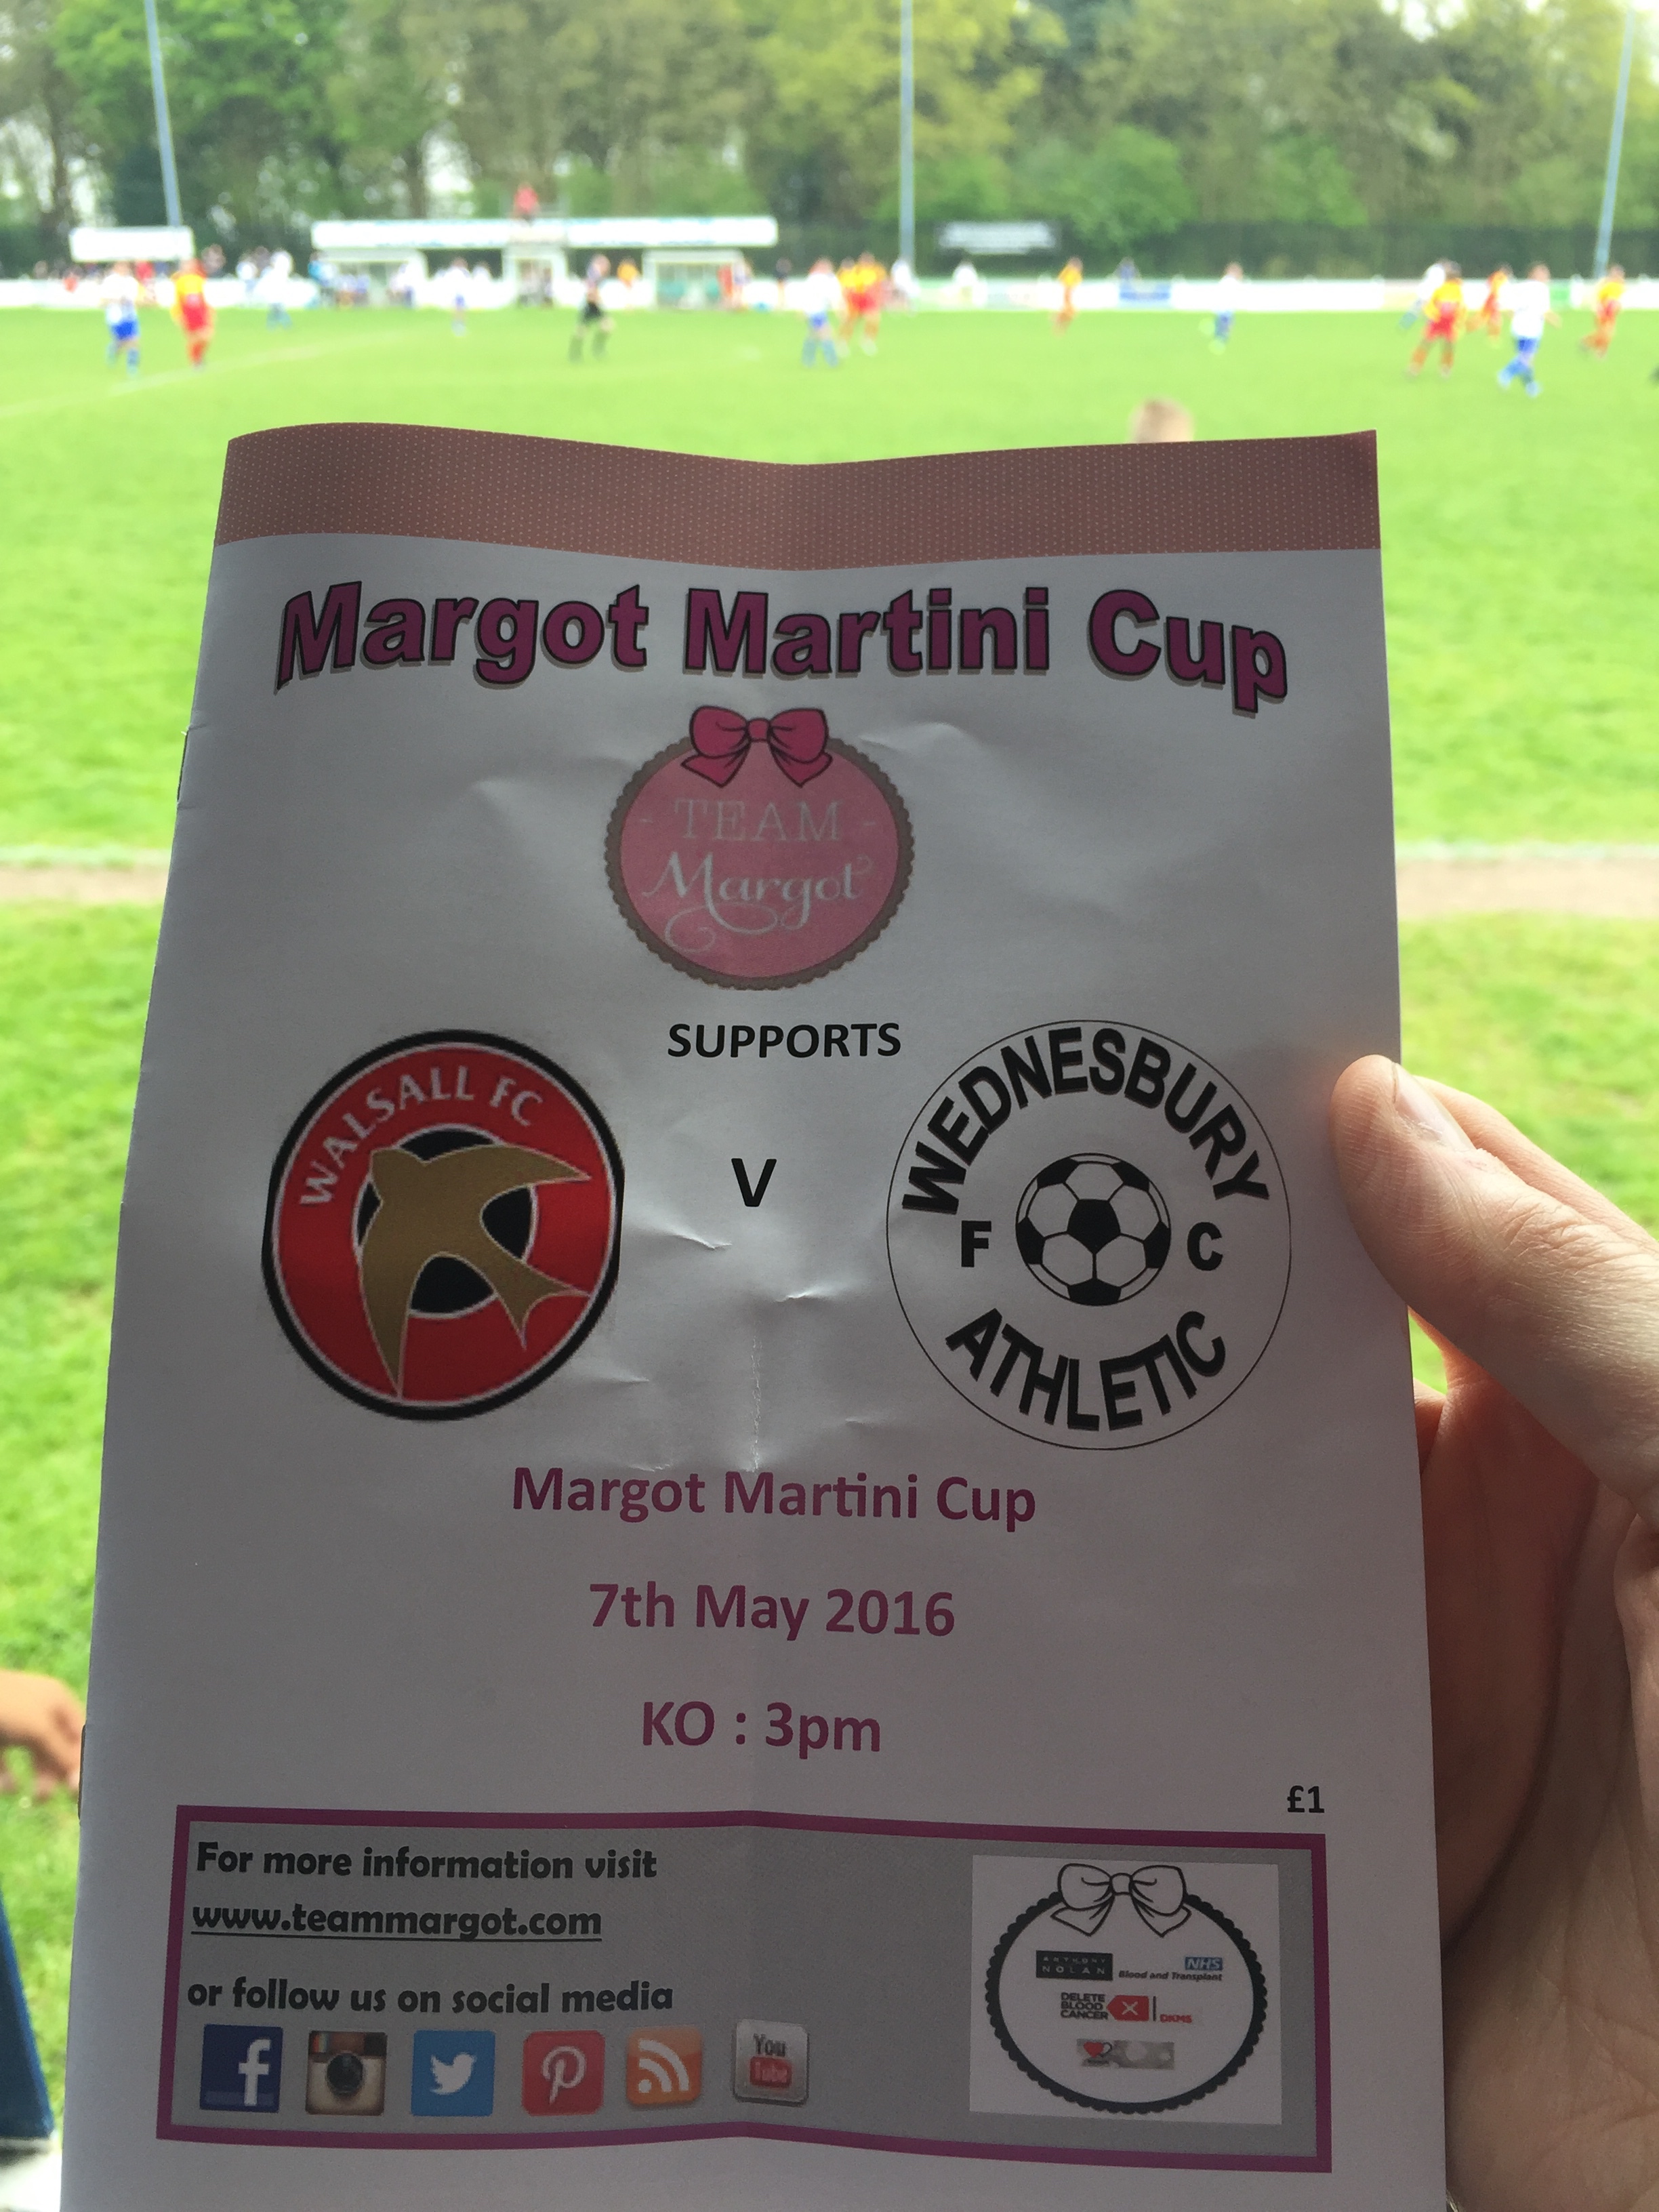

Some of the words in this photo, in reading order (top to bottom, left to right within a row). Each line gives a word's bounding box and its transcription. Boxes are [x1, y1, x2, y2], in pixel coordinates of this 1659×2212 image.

[274, 581, 649, 690] Margot
[683, 587, 1049, 676] Martini
[1088, 589, 1288, 718] Cup
[674, 797, 841, 842] TEAM
[641, 851, 874, 954] Margot
[668, 1023, 901, 1058] SUPPORTS
[300, 1065, 476, 1206] WALSALL
[489, 1076, 542, 1126] FC
[901, 1026, 1270, 1215] WEDNESBURY
[731, 1158, 777, 1208] V
[961, 1220, 991, 1267] F
[1187, 1221, 1223, 1271] C
[945, 1308, 1225, 1431] ATHLETIC
[512, 1467, 705, 1523] Margot
[724, 1471, 918, 1519] Martini
[937, 1477, 1036, 1532] Cup
[589, 1580, 676, 1628] 7th
[695, 1584, 810, 1641] May
[825, 1589, 955, 1636] 2016
[642, 1702, 715, 1746] KO
[735, 1713, 746, 1744] :
[764, 1703, 880, 1759] 3pm
[1287, 1785, 1325, 1814] £1
[197, 1842, 252, 1873] For
[263, 1849, 352, 1877] more
[363, 1846, 573, 1879] information
[585, 1849, 657, 1879] visit
[192, 1904, 602, 1942] www.teammargot.com
[1042, 1965, 1106, 1975] NOLAN
[1118, 1970, 1147, 1980] Blood
[1149, 1971, 1168, 1980] and
[1171, 1972, 1223, 1982] Transplant
[1186, 1957, 1222, 1969] NHS
[188, 1981, 222, 2007] or
[233, 1977, 340, 2011] follow
[351, 1986, 387, 2012] us
[397, 1987, 441, 2012] on
[451, 1982, 550, 2013] social
[561, 1981, 674, 2012] media
[1061, 1992, 1105, 2002] DELETE
[1061, 2001, 1103, 2011] BLOOD
[1061, 2010, 1109, 2020] CANCER
[754, 2034, 787, 2056] You
